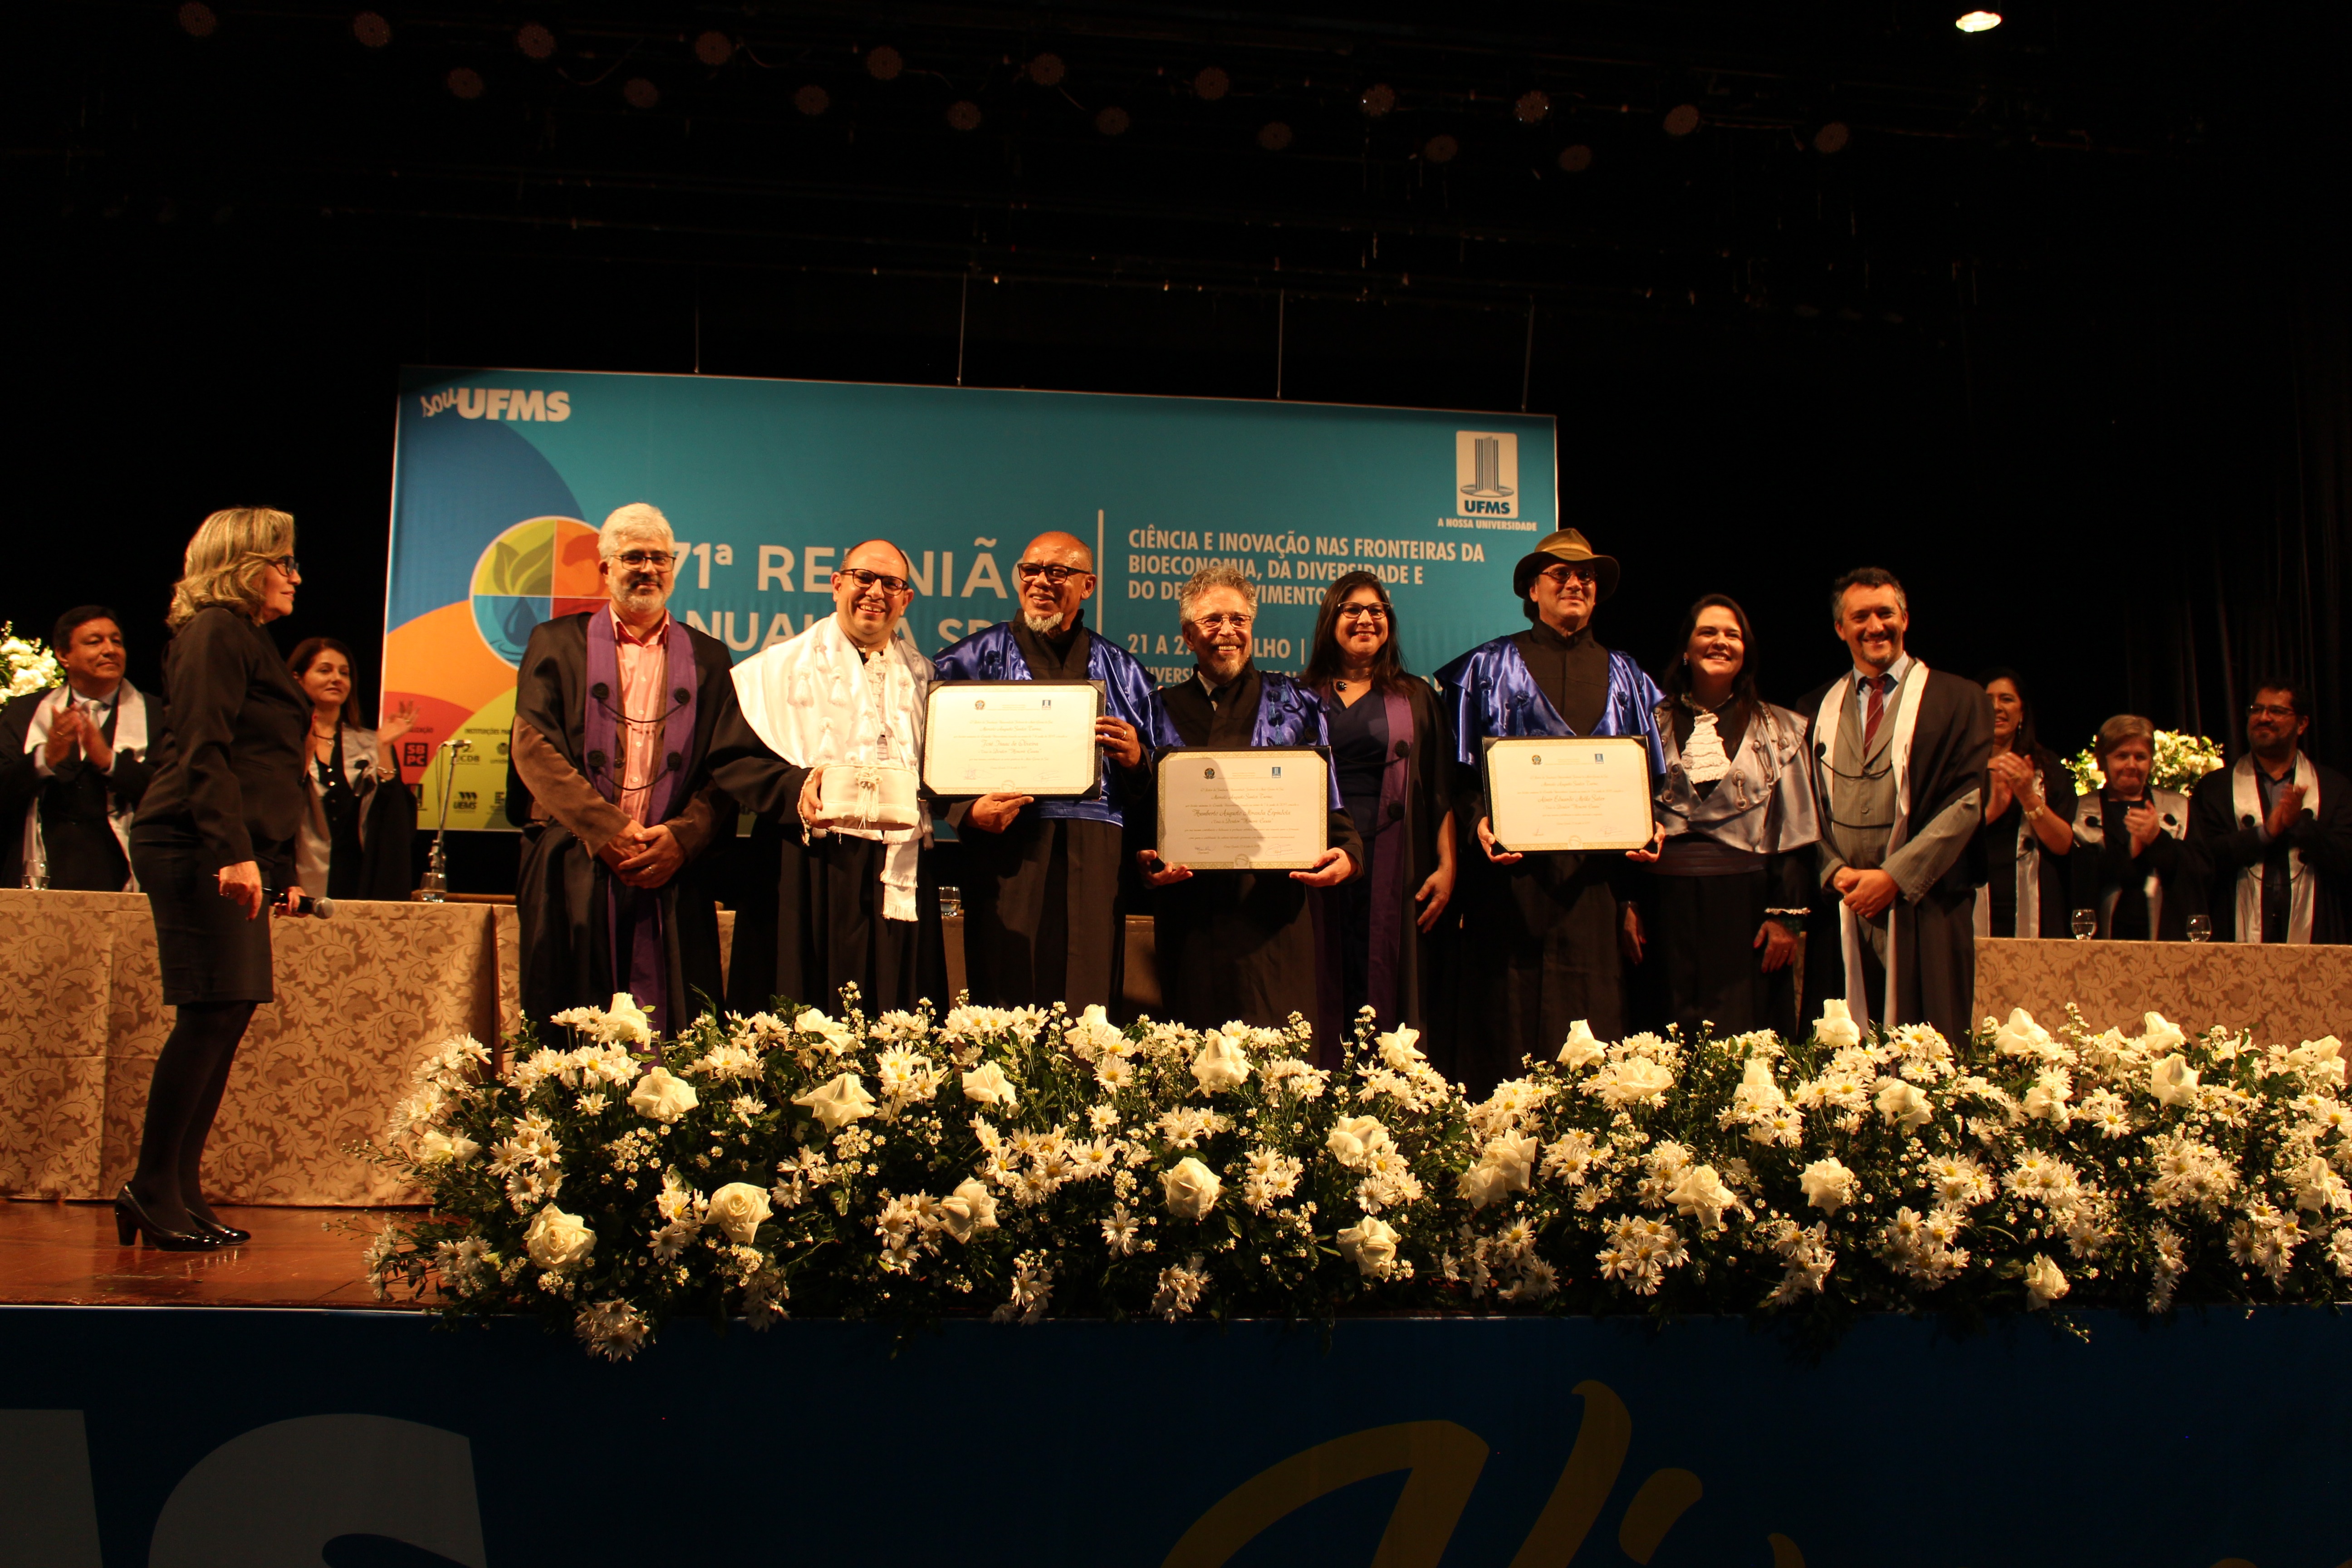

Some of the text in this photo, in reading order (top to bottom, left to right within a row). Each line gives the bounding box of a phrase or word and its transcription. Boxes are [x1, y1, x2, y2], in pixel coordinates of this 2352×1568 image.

[456, 387, 571, 422] UFMS
[1465, 500, 1510, 514] UFMS
[1437, 517, 1538, 532] A NOSSA UNIVERSIDADE
[1128, 524, 1485, 563] CIÊNCIA E INOVAÇÃO NAS FRONTEIRAS DA
[1268, 559, 1292, 579] DA
[1414, 565, 1423, 585] E
[1128, 579, 1155, 599] DO
[1128, 633, 1148, 654] 21
[1155, 634, 1168, 654] A
